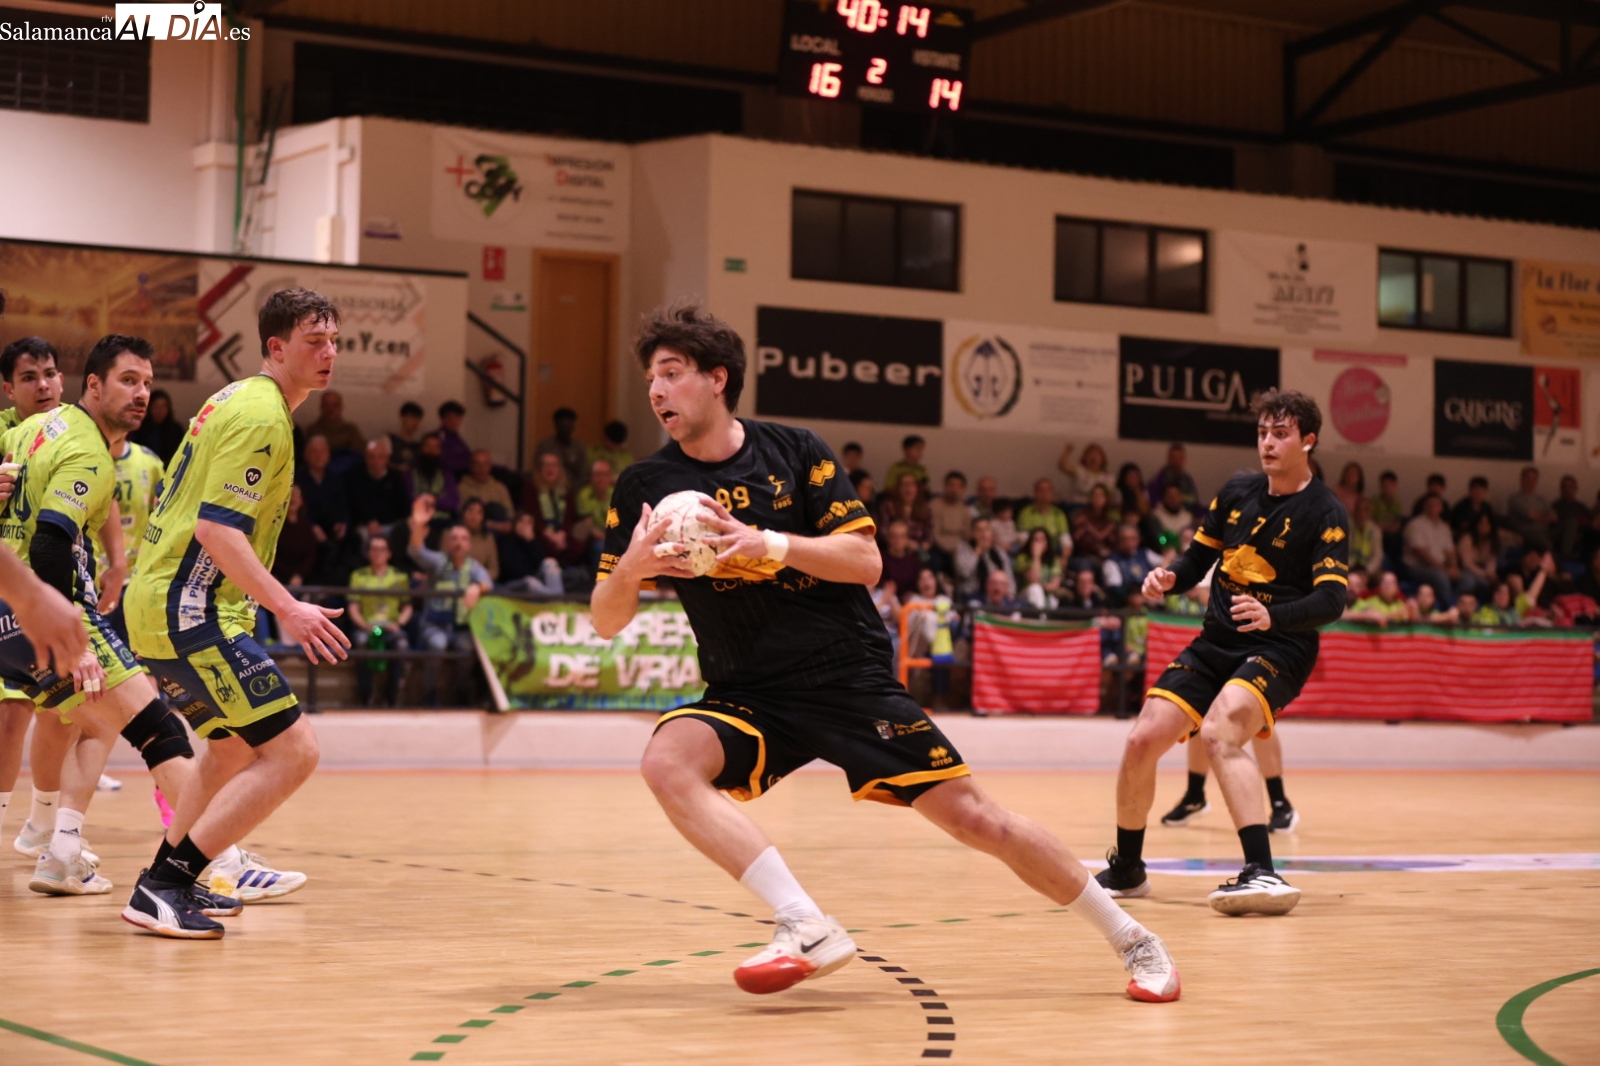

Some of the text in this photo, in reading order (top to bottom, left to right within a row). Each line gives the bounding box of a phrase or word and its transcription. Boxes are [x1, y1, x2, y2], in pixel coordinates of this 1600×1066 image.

[790, 34, 842, 56] LOCAL
[808, 62, 843, 98] 16
[866, 57, 888, 84] 2
[928, 77, 963, 111] 14
[757, 346, 942, 386] Pubeer
[1251, 517, 1267, 536] 7
[544, 653, 601, 688] DE
